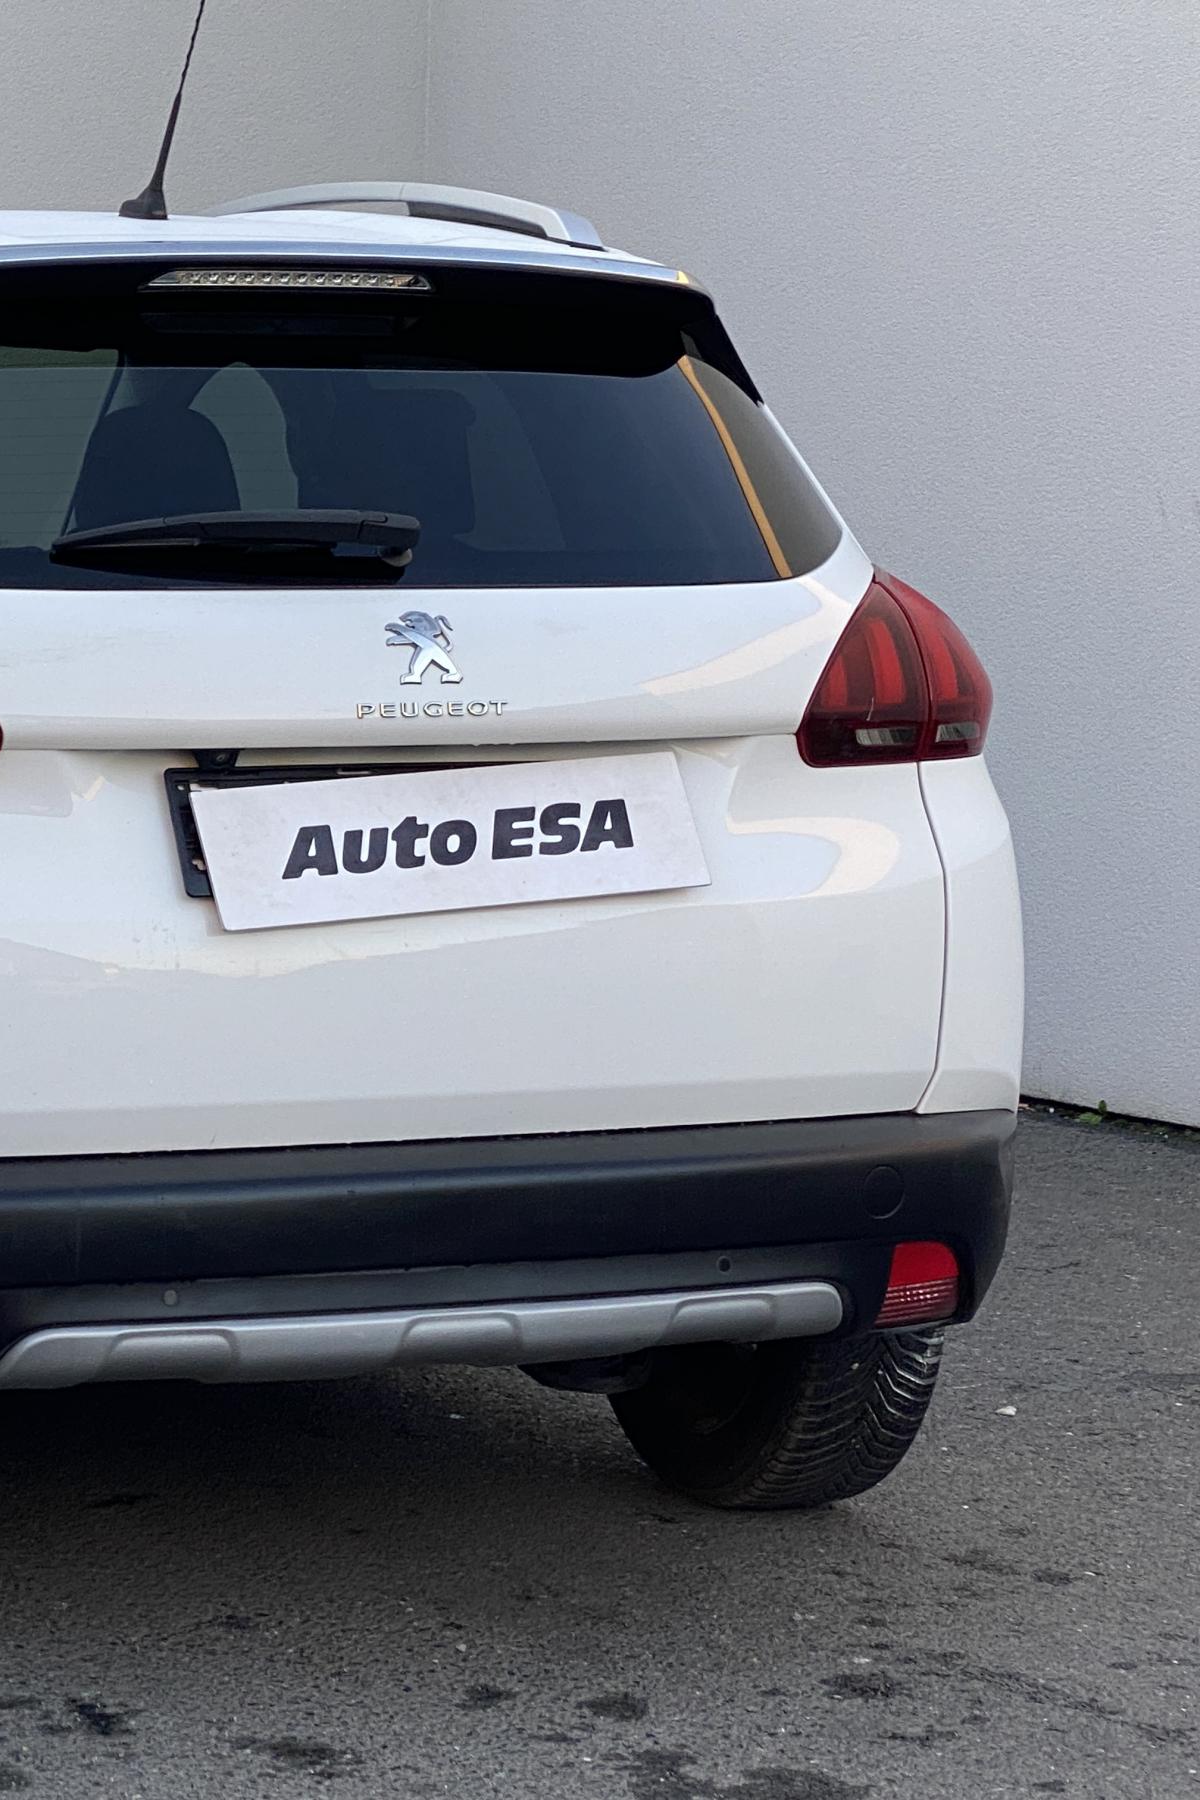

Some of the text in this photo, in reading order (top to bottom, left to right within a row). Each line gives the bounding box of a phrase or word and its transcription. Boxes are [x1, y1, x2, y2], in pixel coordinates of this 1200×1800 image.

[356, 700, 507, 719] PEUGEOT
[282, 798, 634, 880] Auto ESA
